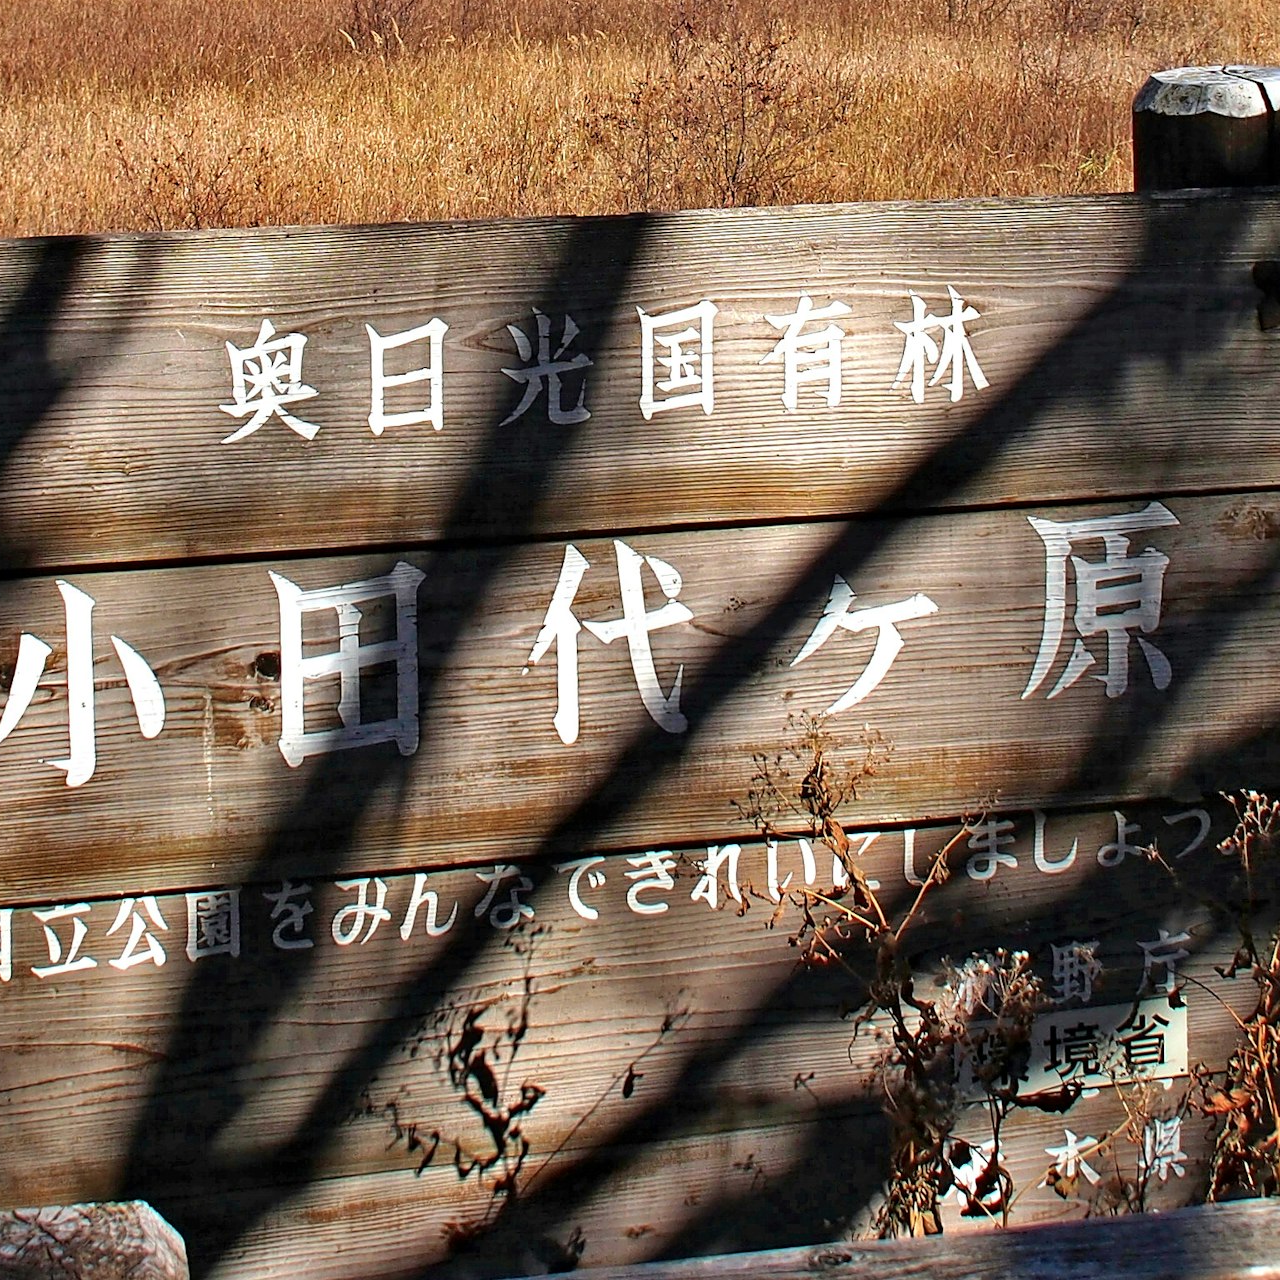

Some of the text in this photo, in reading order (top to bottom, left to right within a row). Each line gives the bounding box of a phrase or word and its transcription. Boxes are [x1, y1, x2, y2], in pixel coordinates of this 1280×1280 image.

[220, 285, 991, 444] 奥日光国有林
